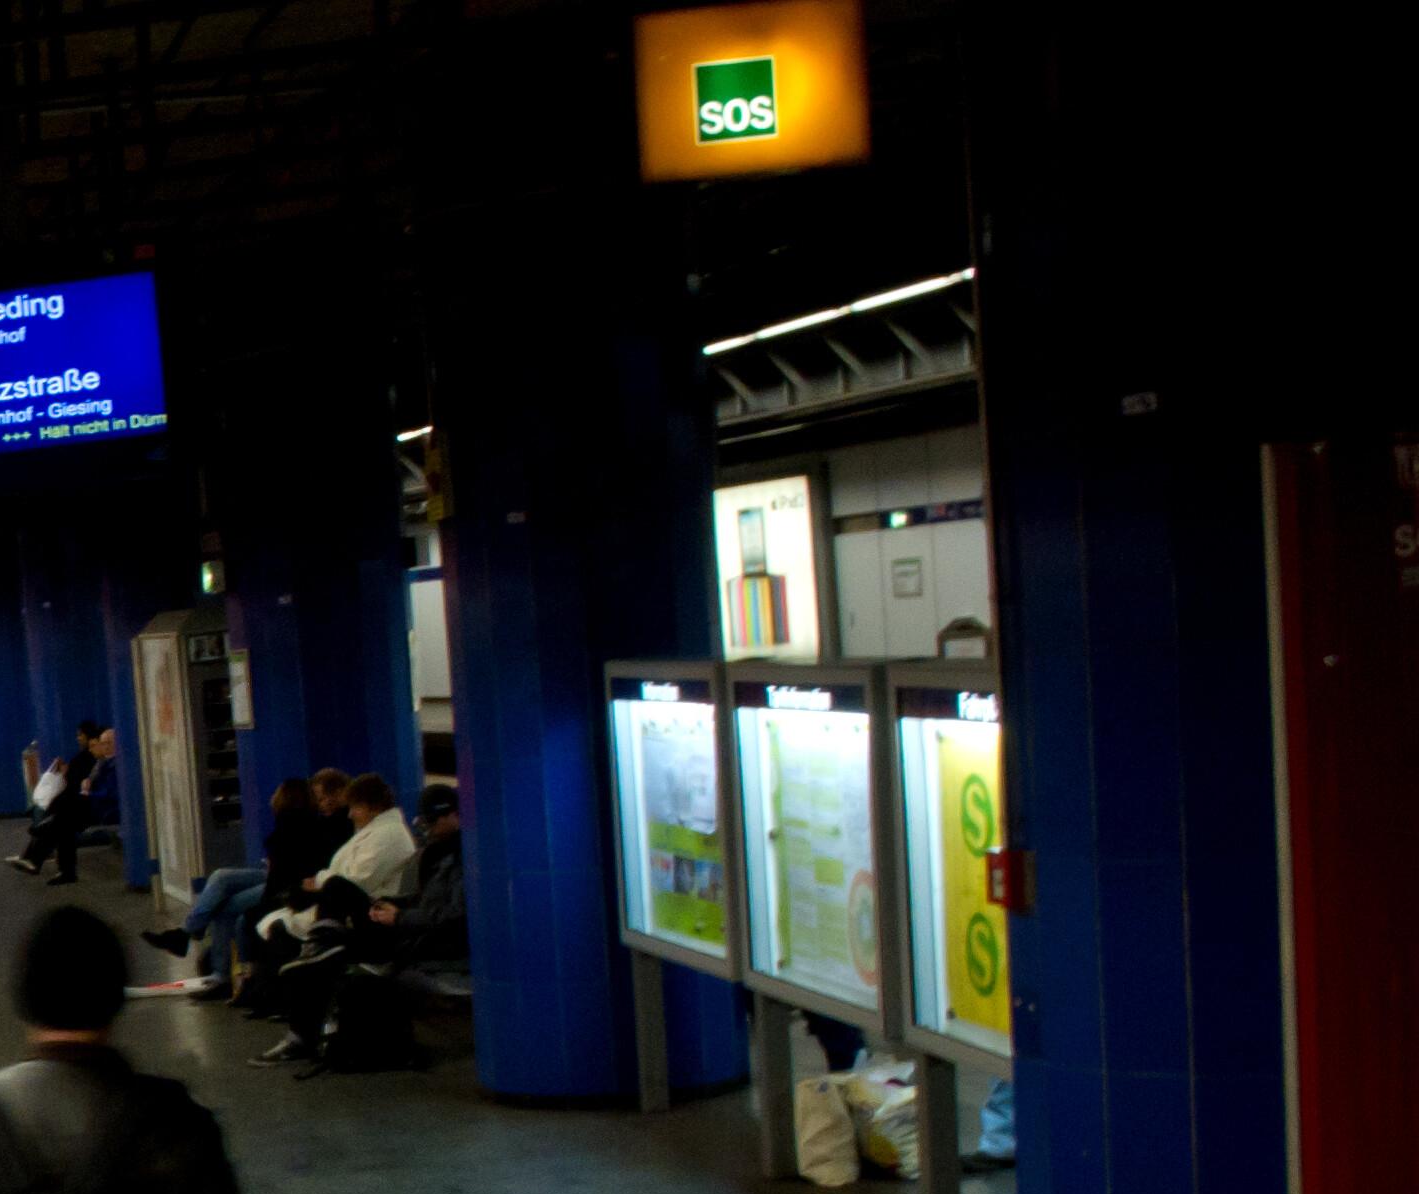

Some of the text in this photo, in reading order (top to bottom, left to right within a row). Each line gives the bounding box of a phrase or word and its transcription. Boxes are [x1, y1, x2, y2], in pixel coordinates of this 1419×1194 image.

[699, 96, 775, 135] SOS
[47, 399, 113, 418] Giesing
[39, 423, 71, 440] Hält
[73, 419, 110, 436] nicht
[112, 418, 127, 430] in
